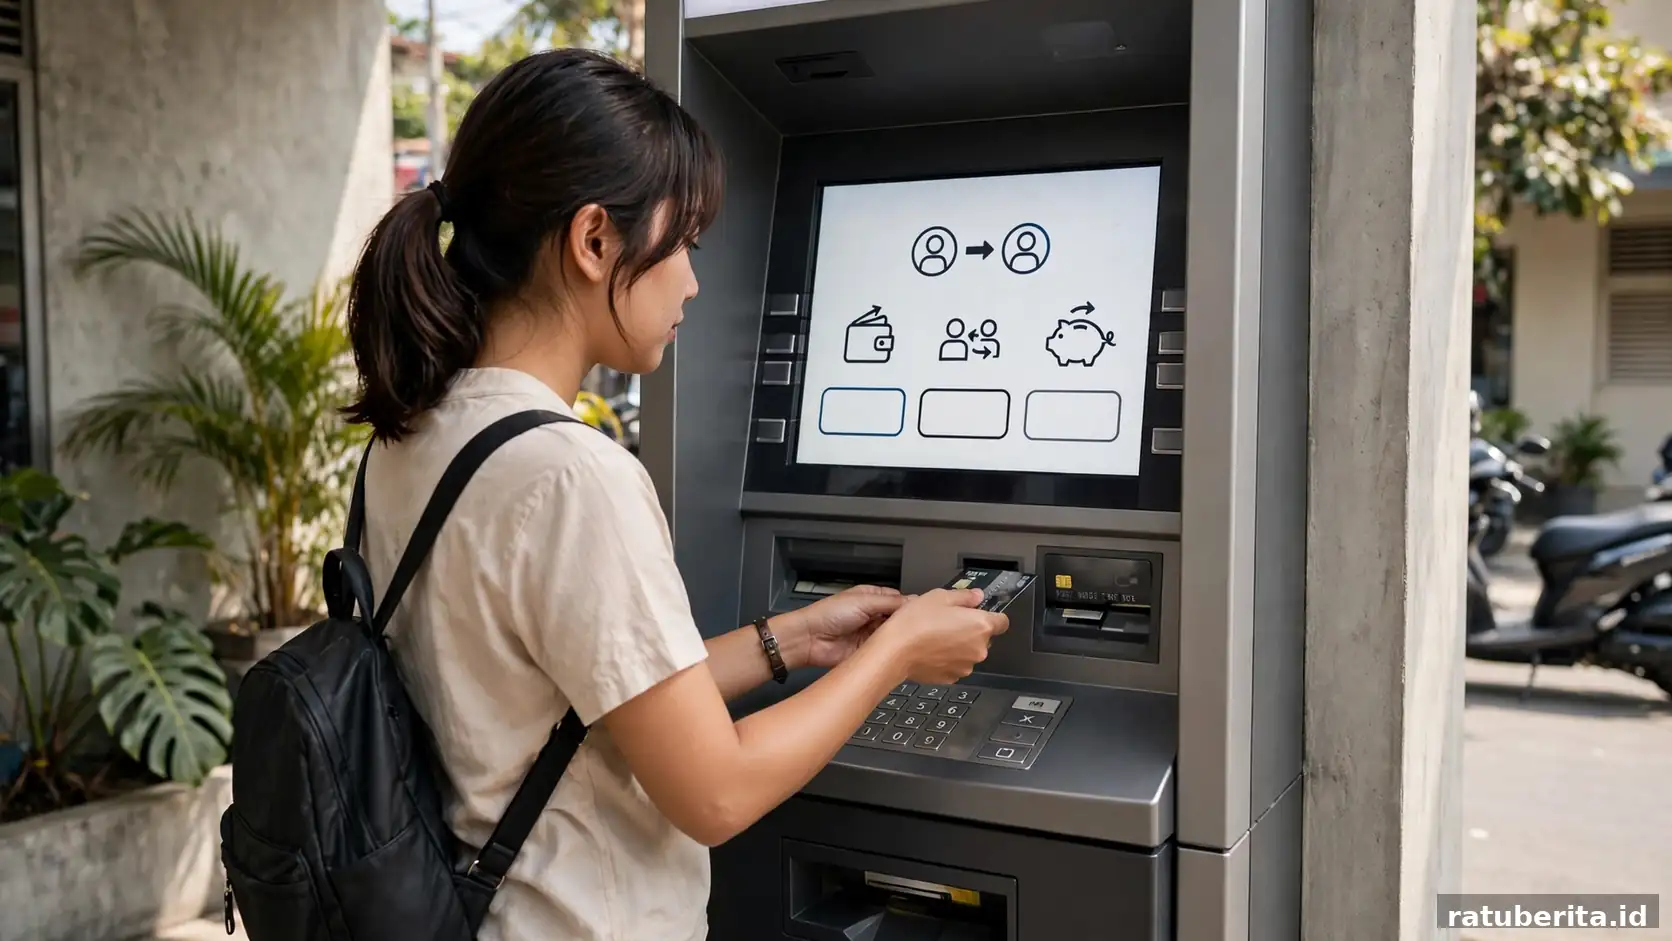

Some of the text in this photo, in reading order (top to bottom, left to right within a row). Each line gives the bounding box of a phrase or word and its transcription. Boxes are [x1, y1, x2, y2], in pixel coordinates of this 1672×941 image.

[899, 684, 968, 699] 1 2 3
[916, 702, 926, 710] 5
[947, 706, 957, 714] 6
[875, 712, 946, 729] 7 8 9
[892, 731, 903, 740] 0
